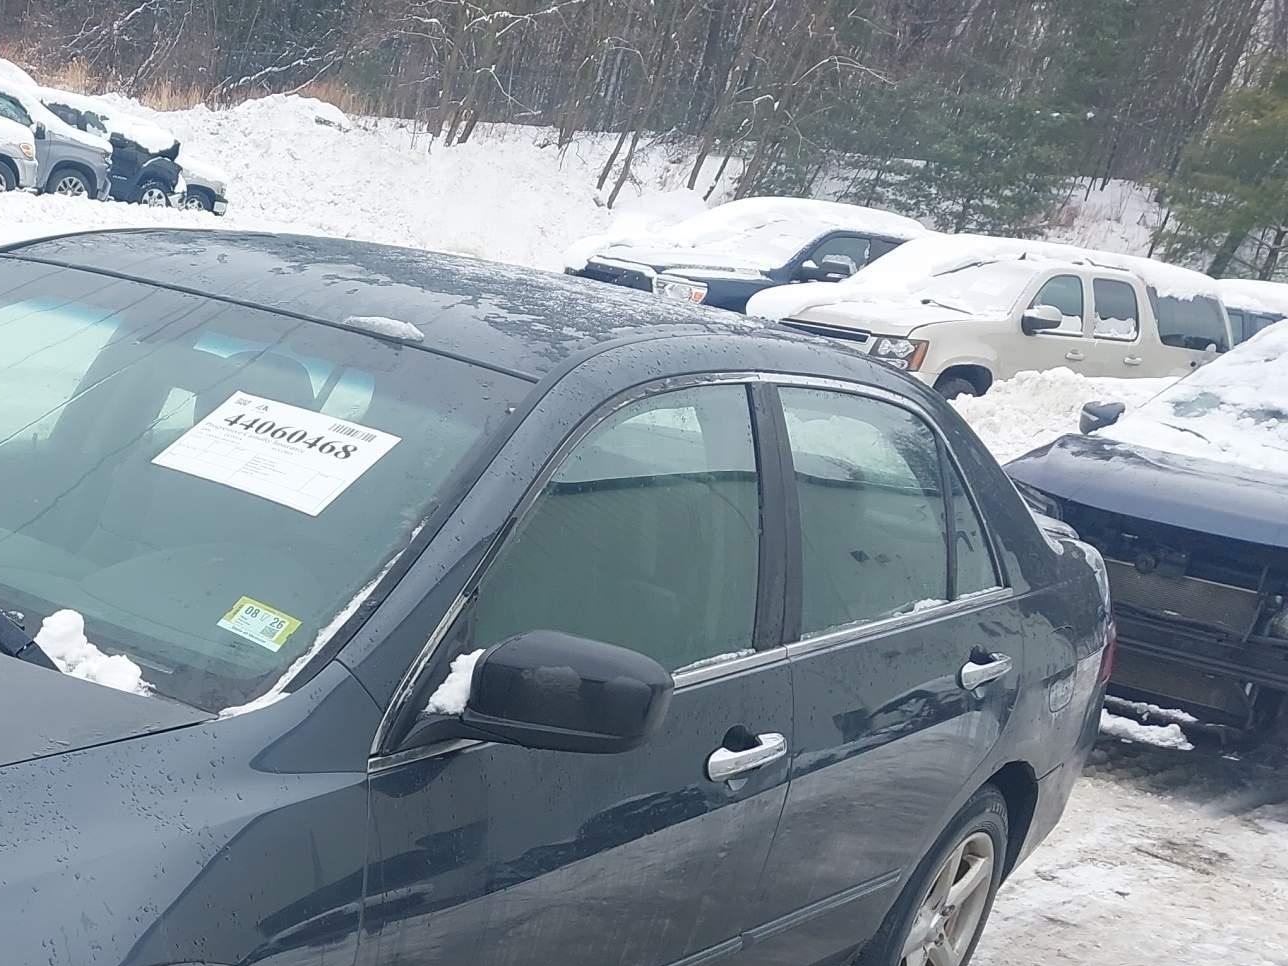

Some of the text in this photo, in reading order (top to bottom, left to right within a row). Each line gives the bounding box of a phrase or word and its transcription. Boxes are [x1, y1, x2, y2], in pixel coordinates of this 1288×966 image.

[223, 413, 358, 460] 44060468
[244, 605, 261, 618] 08
[269, 617, 286, 630] 26
